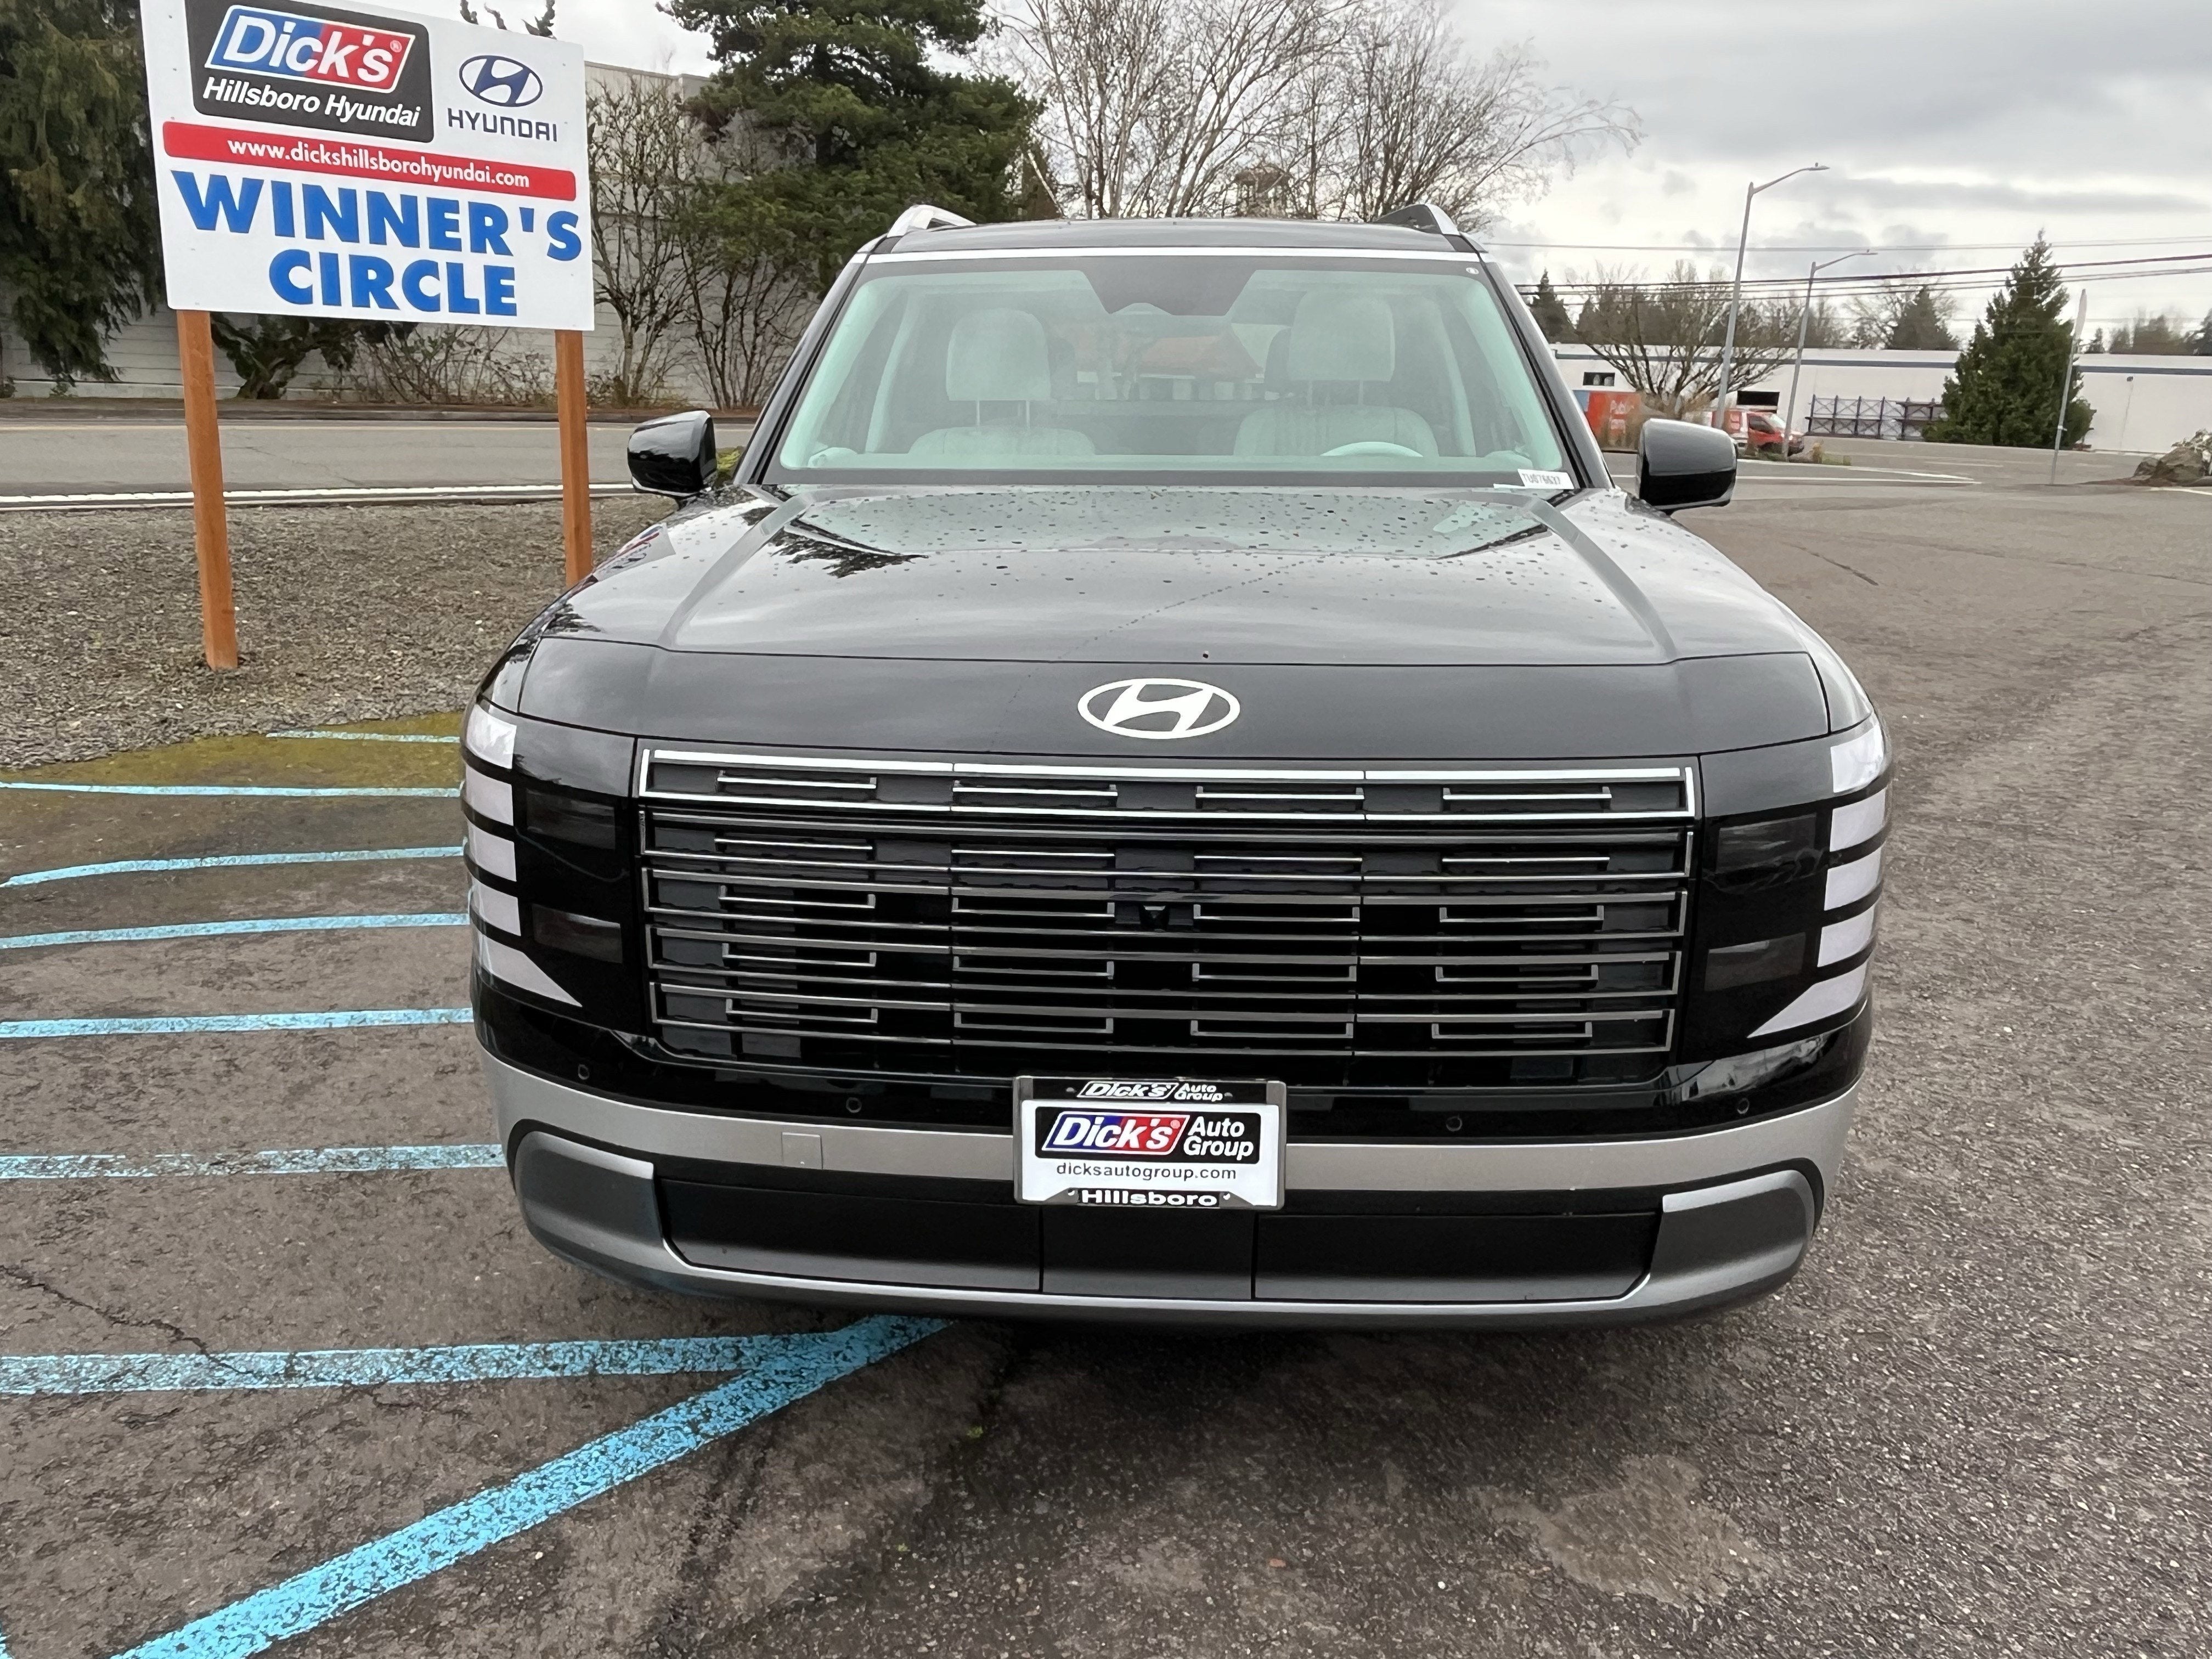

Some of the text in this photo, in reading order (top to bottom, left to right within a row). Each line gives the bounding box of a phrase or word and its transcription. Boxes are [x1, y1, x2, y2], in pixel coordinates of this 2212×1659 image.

[223, 15, 393, 83] Dick's
[202, 76, 421, 127] Hillsboro Hyundai
[447, 108, 557, 142] HYUNDAI
[227, 138, 530, 188] www.dickshillsborohyundai.com
[171, 170, 583, 261] WINNER'S
[269, 249, 517, 317] CIRCLE
[1085, 1083, 1217, 1096] Dick's Auto
[1174, 1092, 1223, 1102] Group
[1051, 1116, 1245, 1149] Dick's Auto
[1183, 1135, 1254, 1161] Group
[1056, 1163, 1237, 1181] dicksautogroup.com
[1082, 1189, 1217, 1206] Hillsboro
